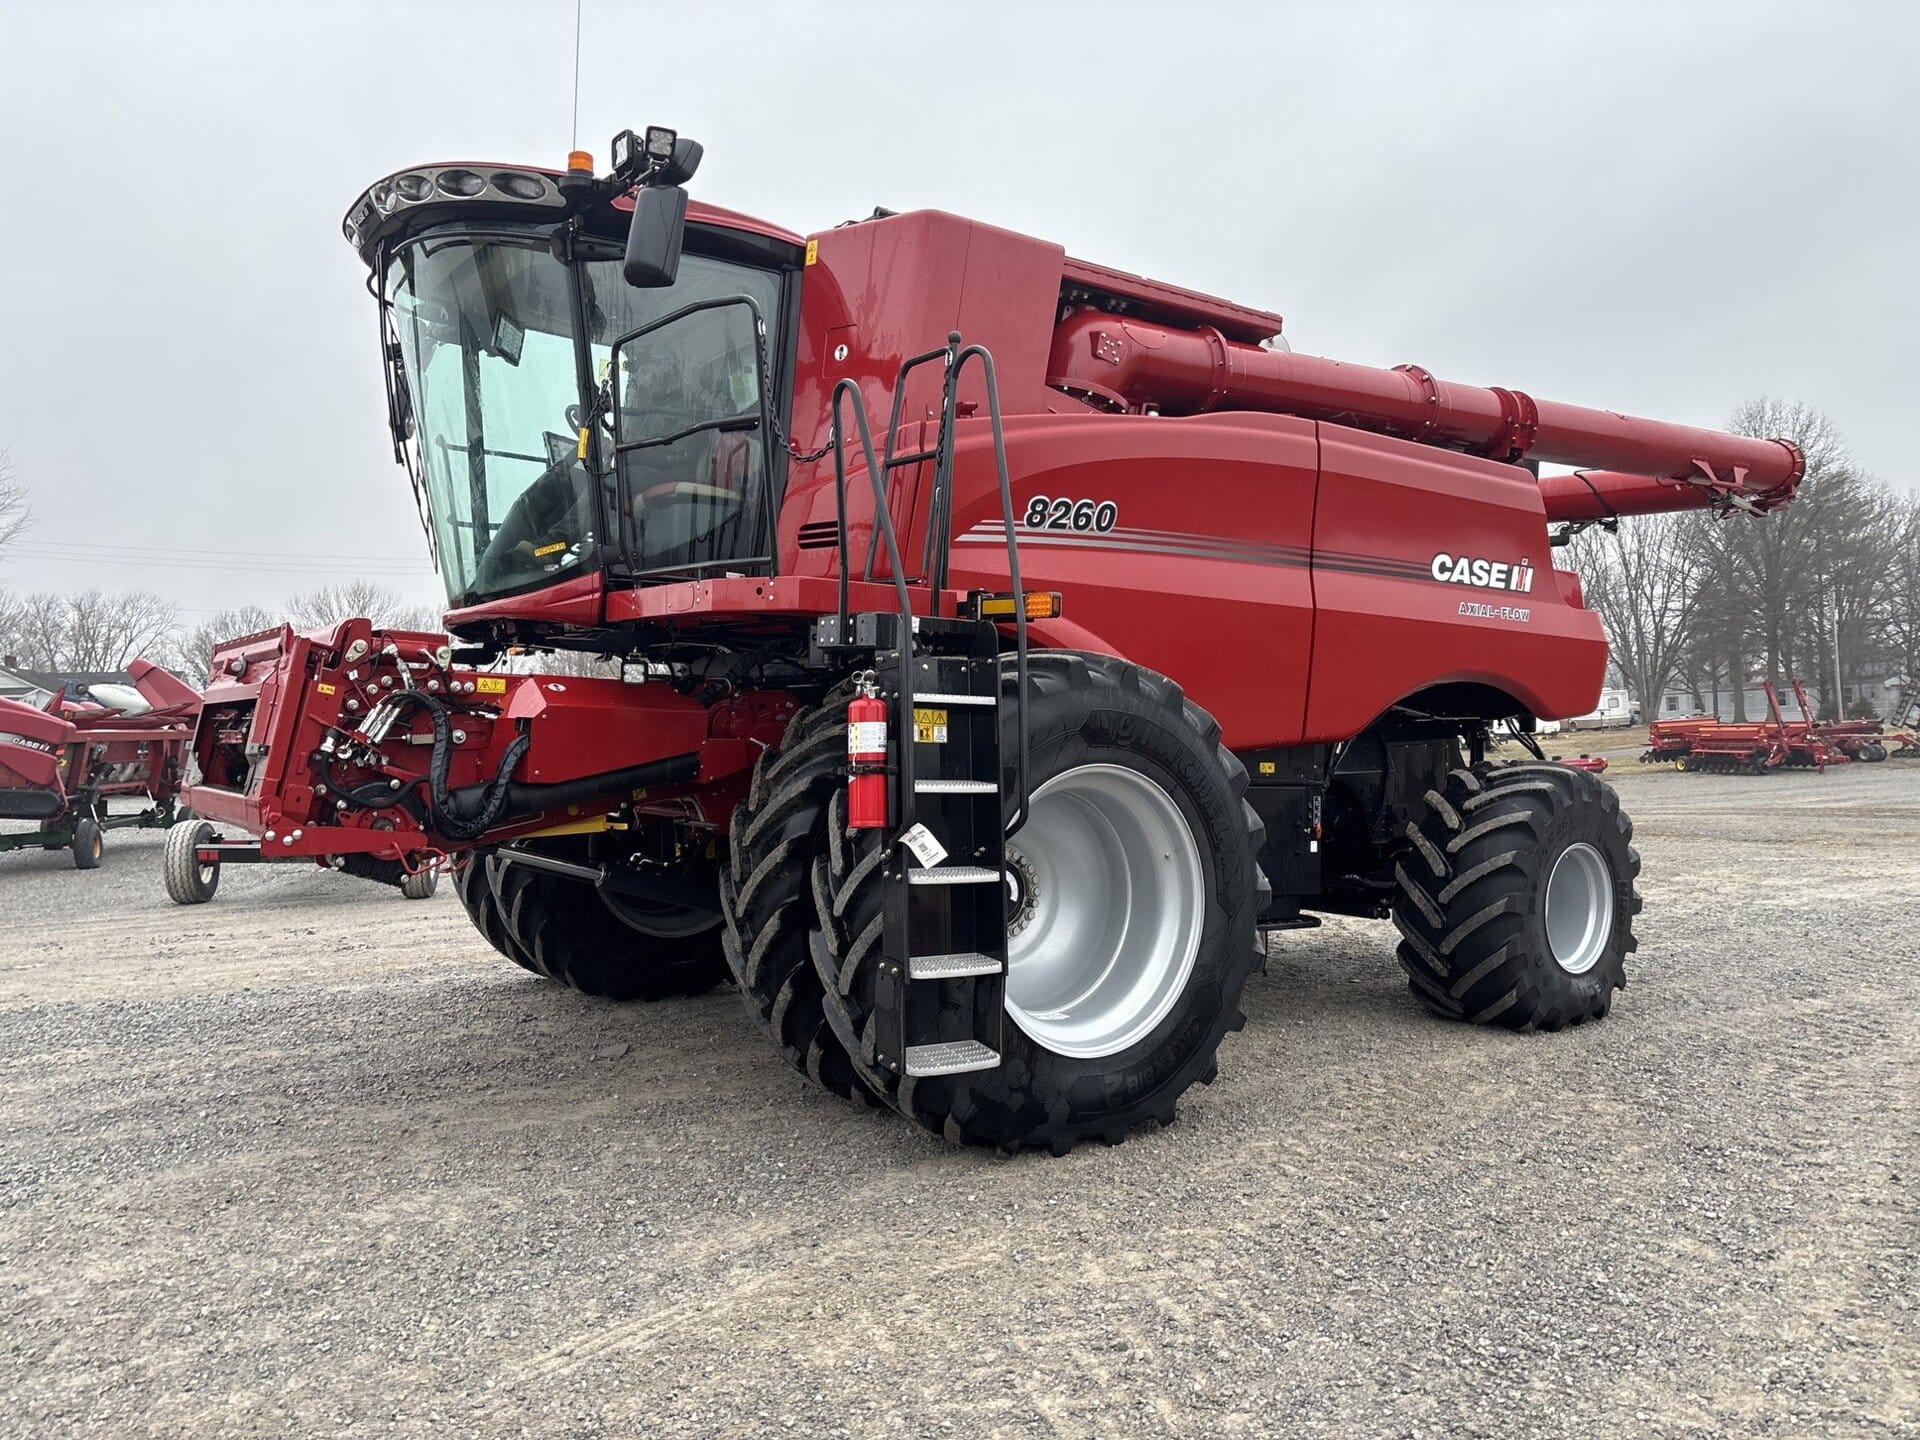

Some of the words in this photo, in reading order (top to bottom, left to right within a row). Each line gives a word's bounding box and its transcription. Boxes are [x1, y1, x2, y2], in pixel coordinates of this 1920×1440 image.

[1024, 495, 1118, 535] 8260
[1431, 553, 1508, 589] CASE
[1459, 602, 1530, 622] AXIAL-FLOW
